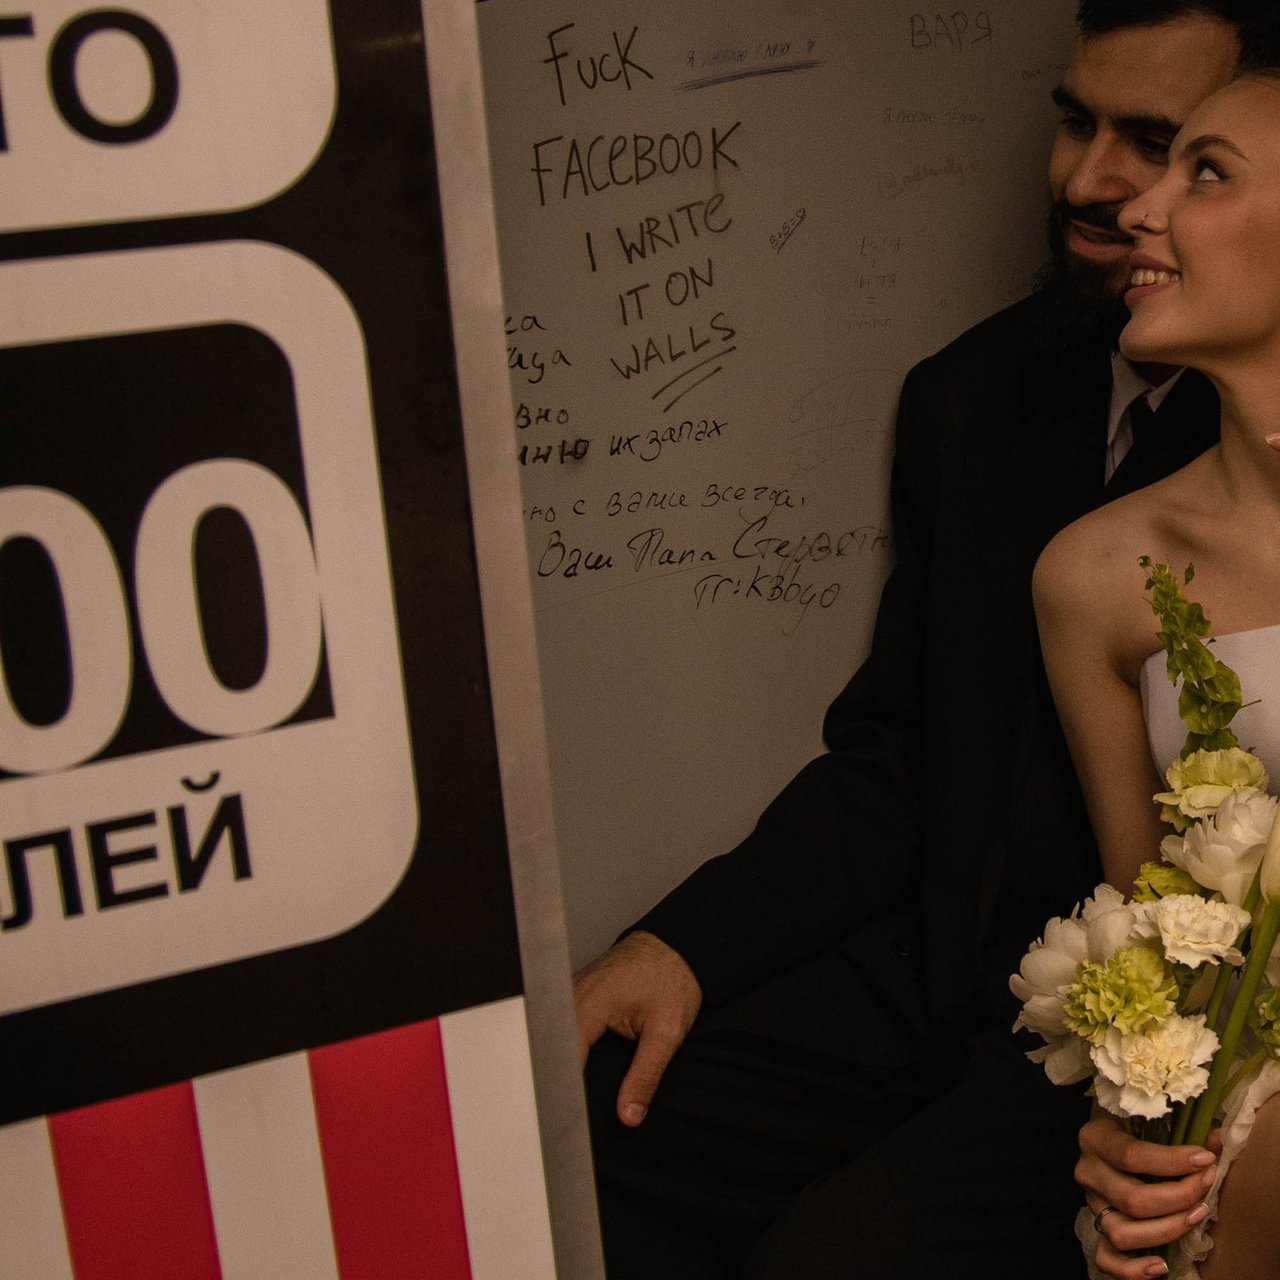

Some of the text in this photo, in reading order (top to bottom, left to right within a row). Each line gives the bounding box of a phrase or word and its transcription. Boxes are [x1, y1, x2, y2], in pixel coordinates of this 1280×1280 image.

[619, 259, 715, 325] IT ON
[609, 311, 737, 380] WALLS
